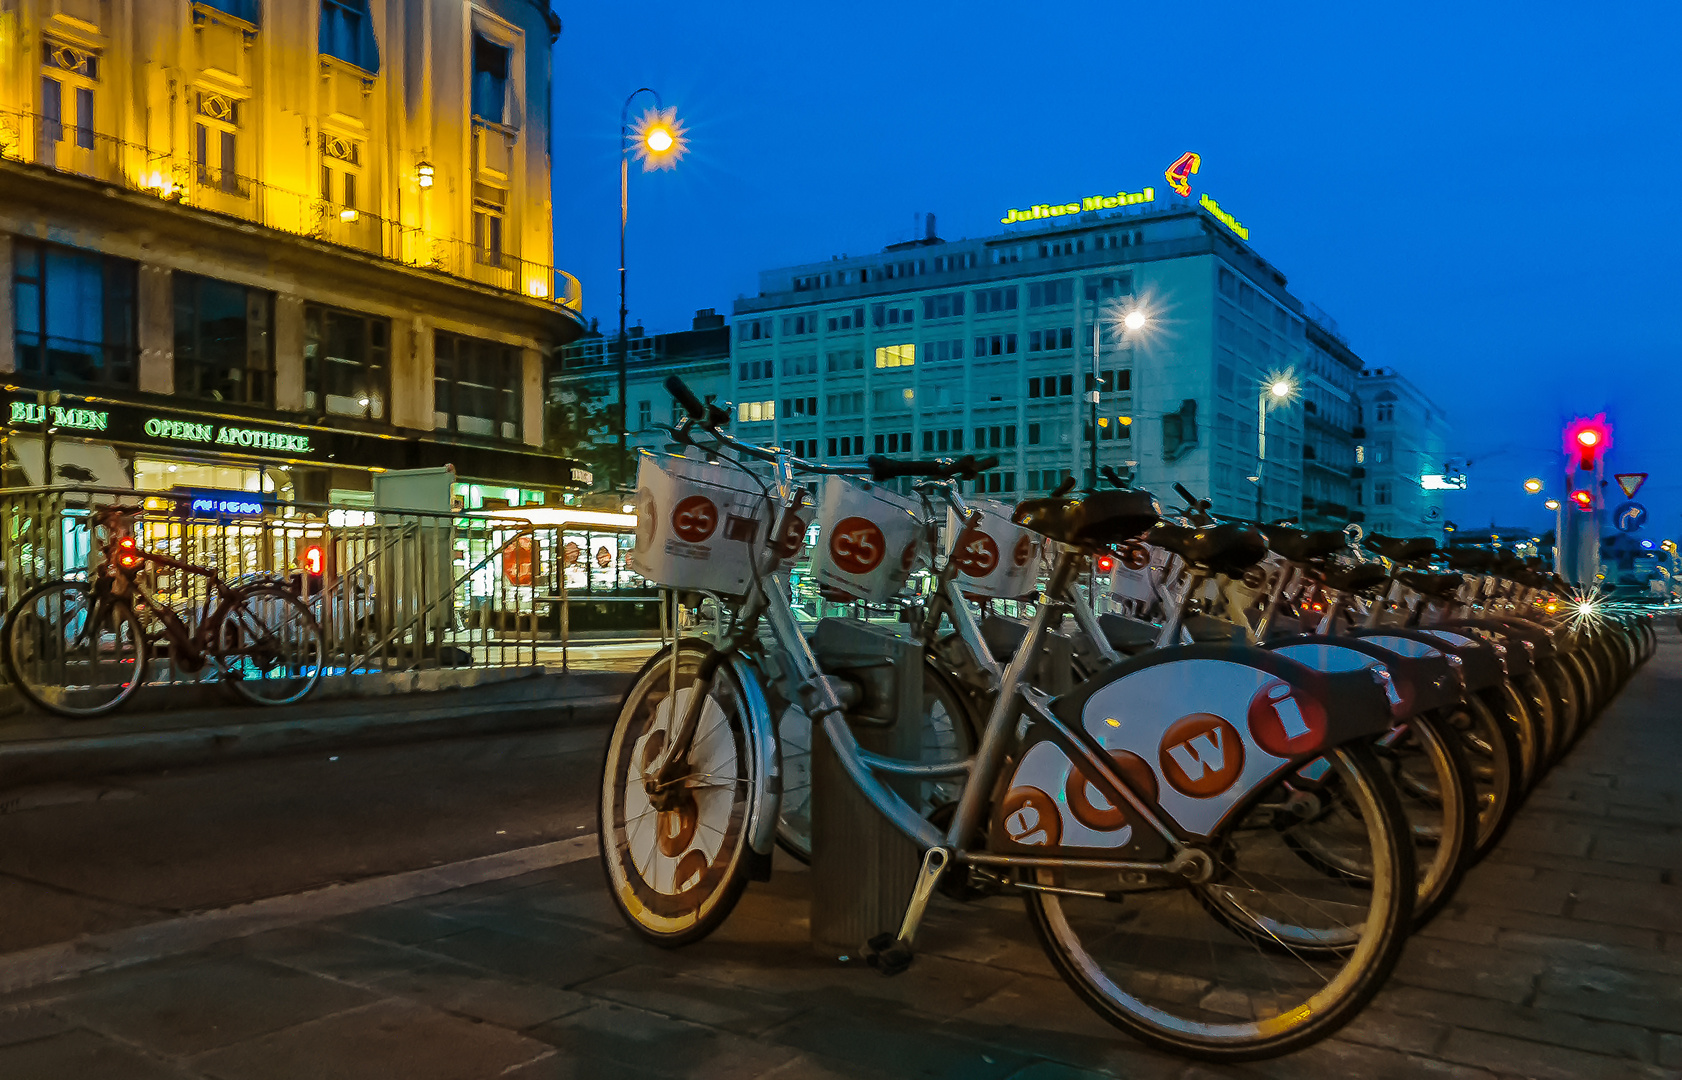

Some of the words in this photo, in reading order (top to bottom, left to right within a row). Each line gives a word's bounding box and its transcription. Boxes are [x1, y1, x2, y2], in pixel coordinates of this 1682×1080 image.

[1000, 203, 1081, 224] Julius
[1082, 187, 1155, 211] Meinl
[143, 418, 214, 442] OPERN
[215, 427, 312, 452] APOTHEKE
